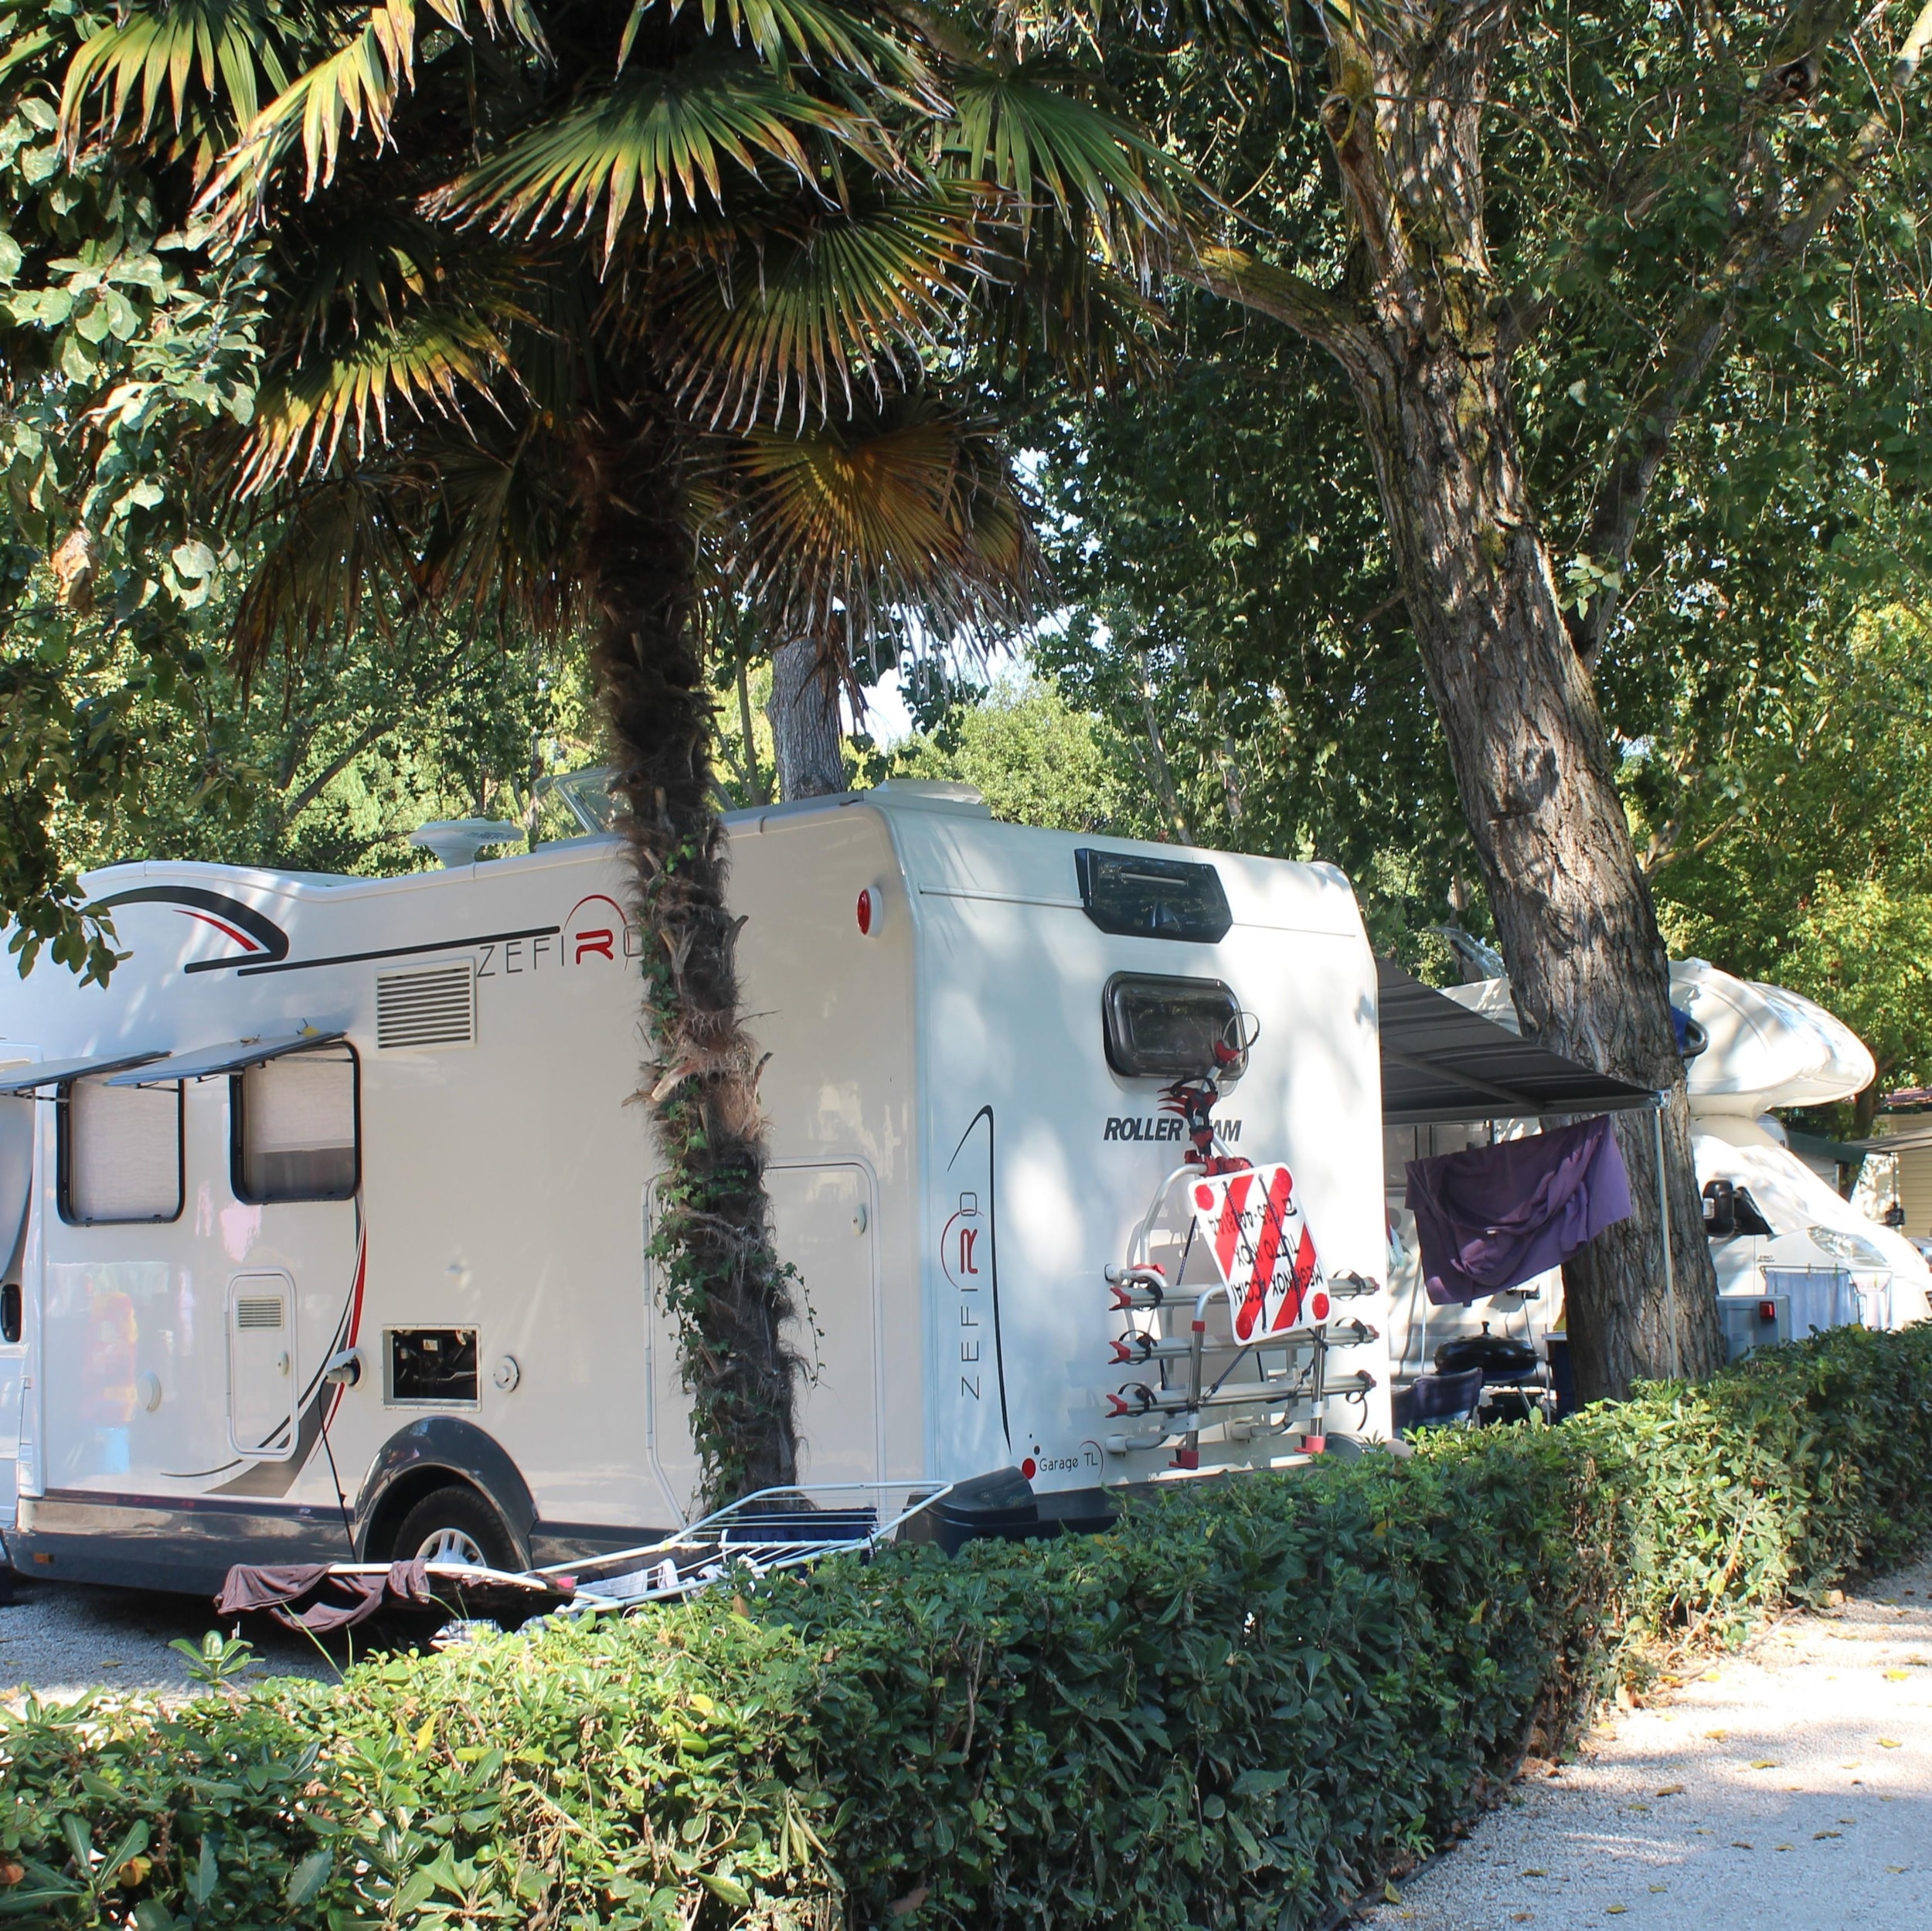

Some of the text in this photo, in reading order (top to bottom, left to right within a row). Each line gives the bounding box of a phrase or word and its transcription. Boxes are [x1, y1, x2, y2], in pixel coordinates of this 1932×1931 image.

[1104, 1117, 1242, 1142] ROLLER AM
[1233, 1233, 1301, 1268] TUTTO INOX
[960, 1192, 979, 1400] ZEFIRO
[1039, 1453, 1098, 1472] Garage TL
